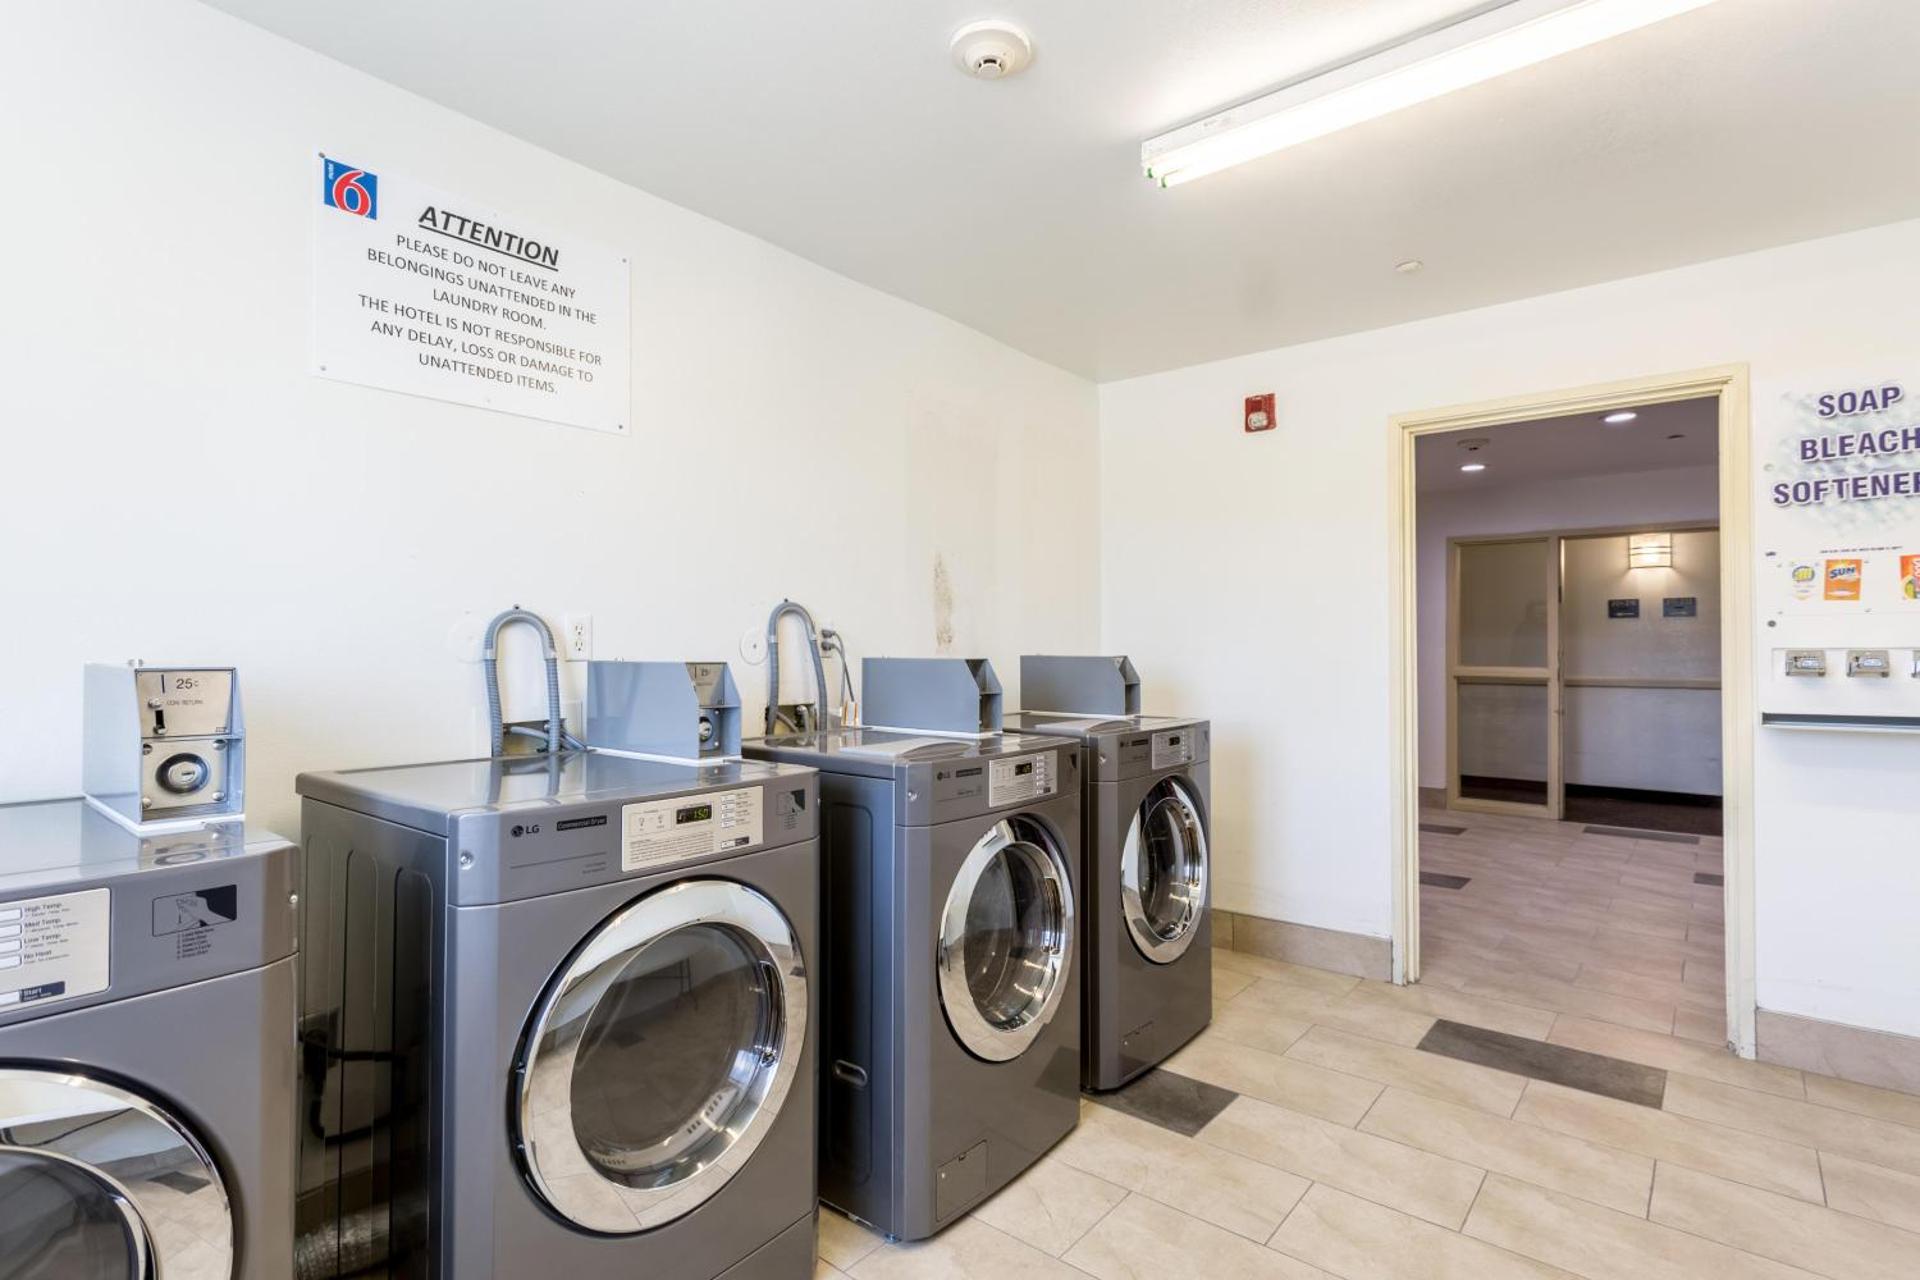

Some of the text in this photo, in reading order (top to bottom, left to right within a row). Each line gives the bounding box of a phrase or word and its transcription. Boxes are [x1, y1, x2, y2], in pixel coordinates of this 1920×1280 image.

[333, 169, 372, 216] 6
[419, 206, 559, 266] ATTENTION
[367, 248, 597, 325] BELONGINGS UNATTENDED IN THE
[397, 235, 576, 299] PLEASE DO NOT LEAVE ANY
[358, 294, 602, 366] THE HOTEL IS NOT RESPONSIBLE FOR
[433, 288, 547, 330] LAUNDRY ROOM.
[370, 320, 593, 382] ANY DELAY, LOSS OR DAMAGE TO
[419, 353, 558, 395] UNATTENDED ITEMS.
[1818, 386, 1901, 417] SOAP
[1800, 427, 1920, 461] BLEACH
[1829, 566, 1856, 580] SUN
[525, 824, 540, 834] LG
